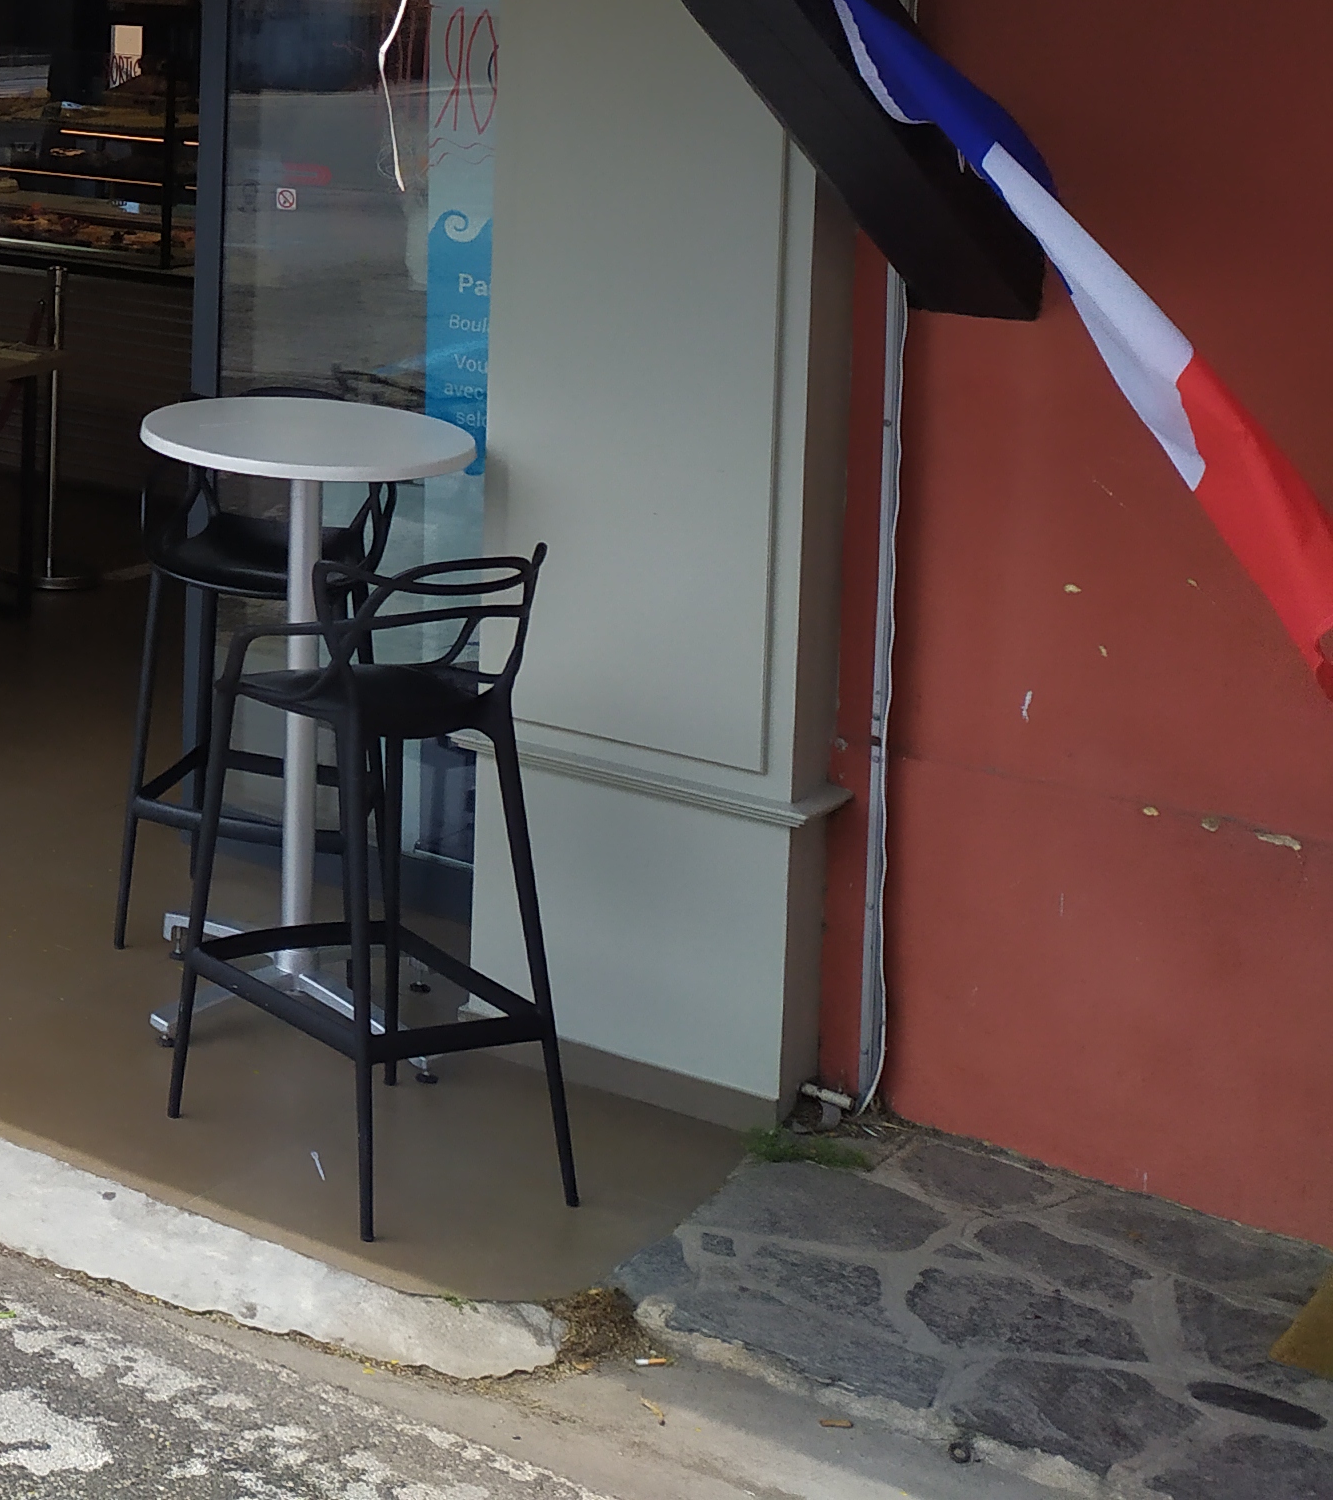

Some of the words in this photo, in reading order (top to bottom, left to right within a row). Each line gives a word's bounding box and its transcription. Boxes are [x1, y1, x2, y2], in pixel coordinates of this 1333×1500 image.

[458, 273, 491, 297] Pa
[449, 314, 490, 334] Boul
[453, 354, 488, 375] Vou
[444, 382, 485, 400] avec
